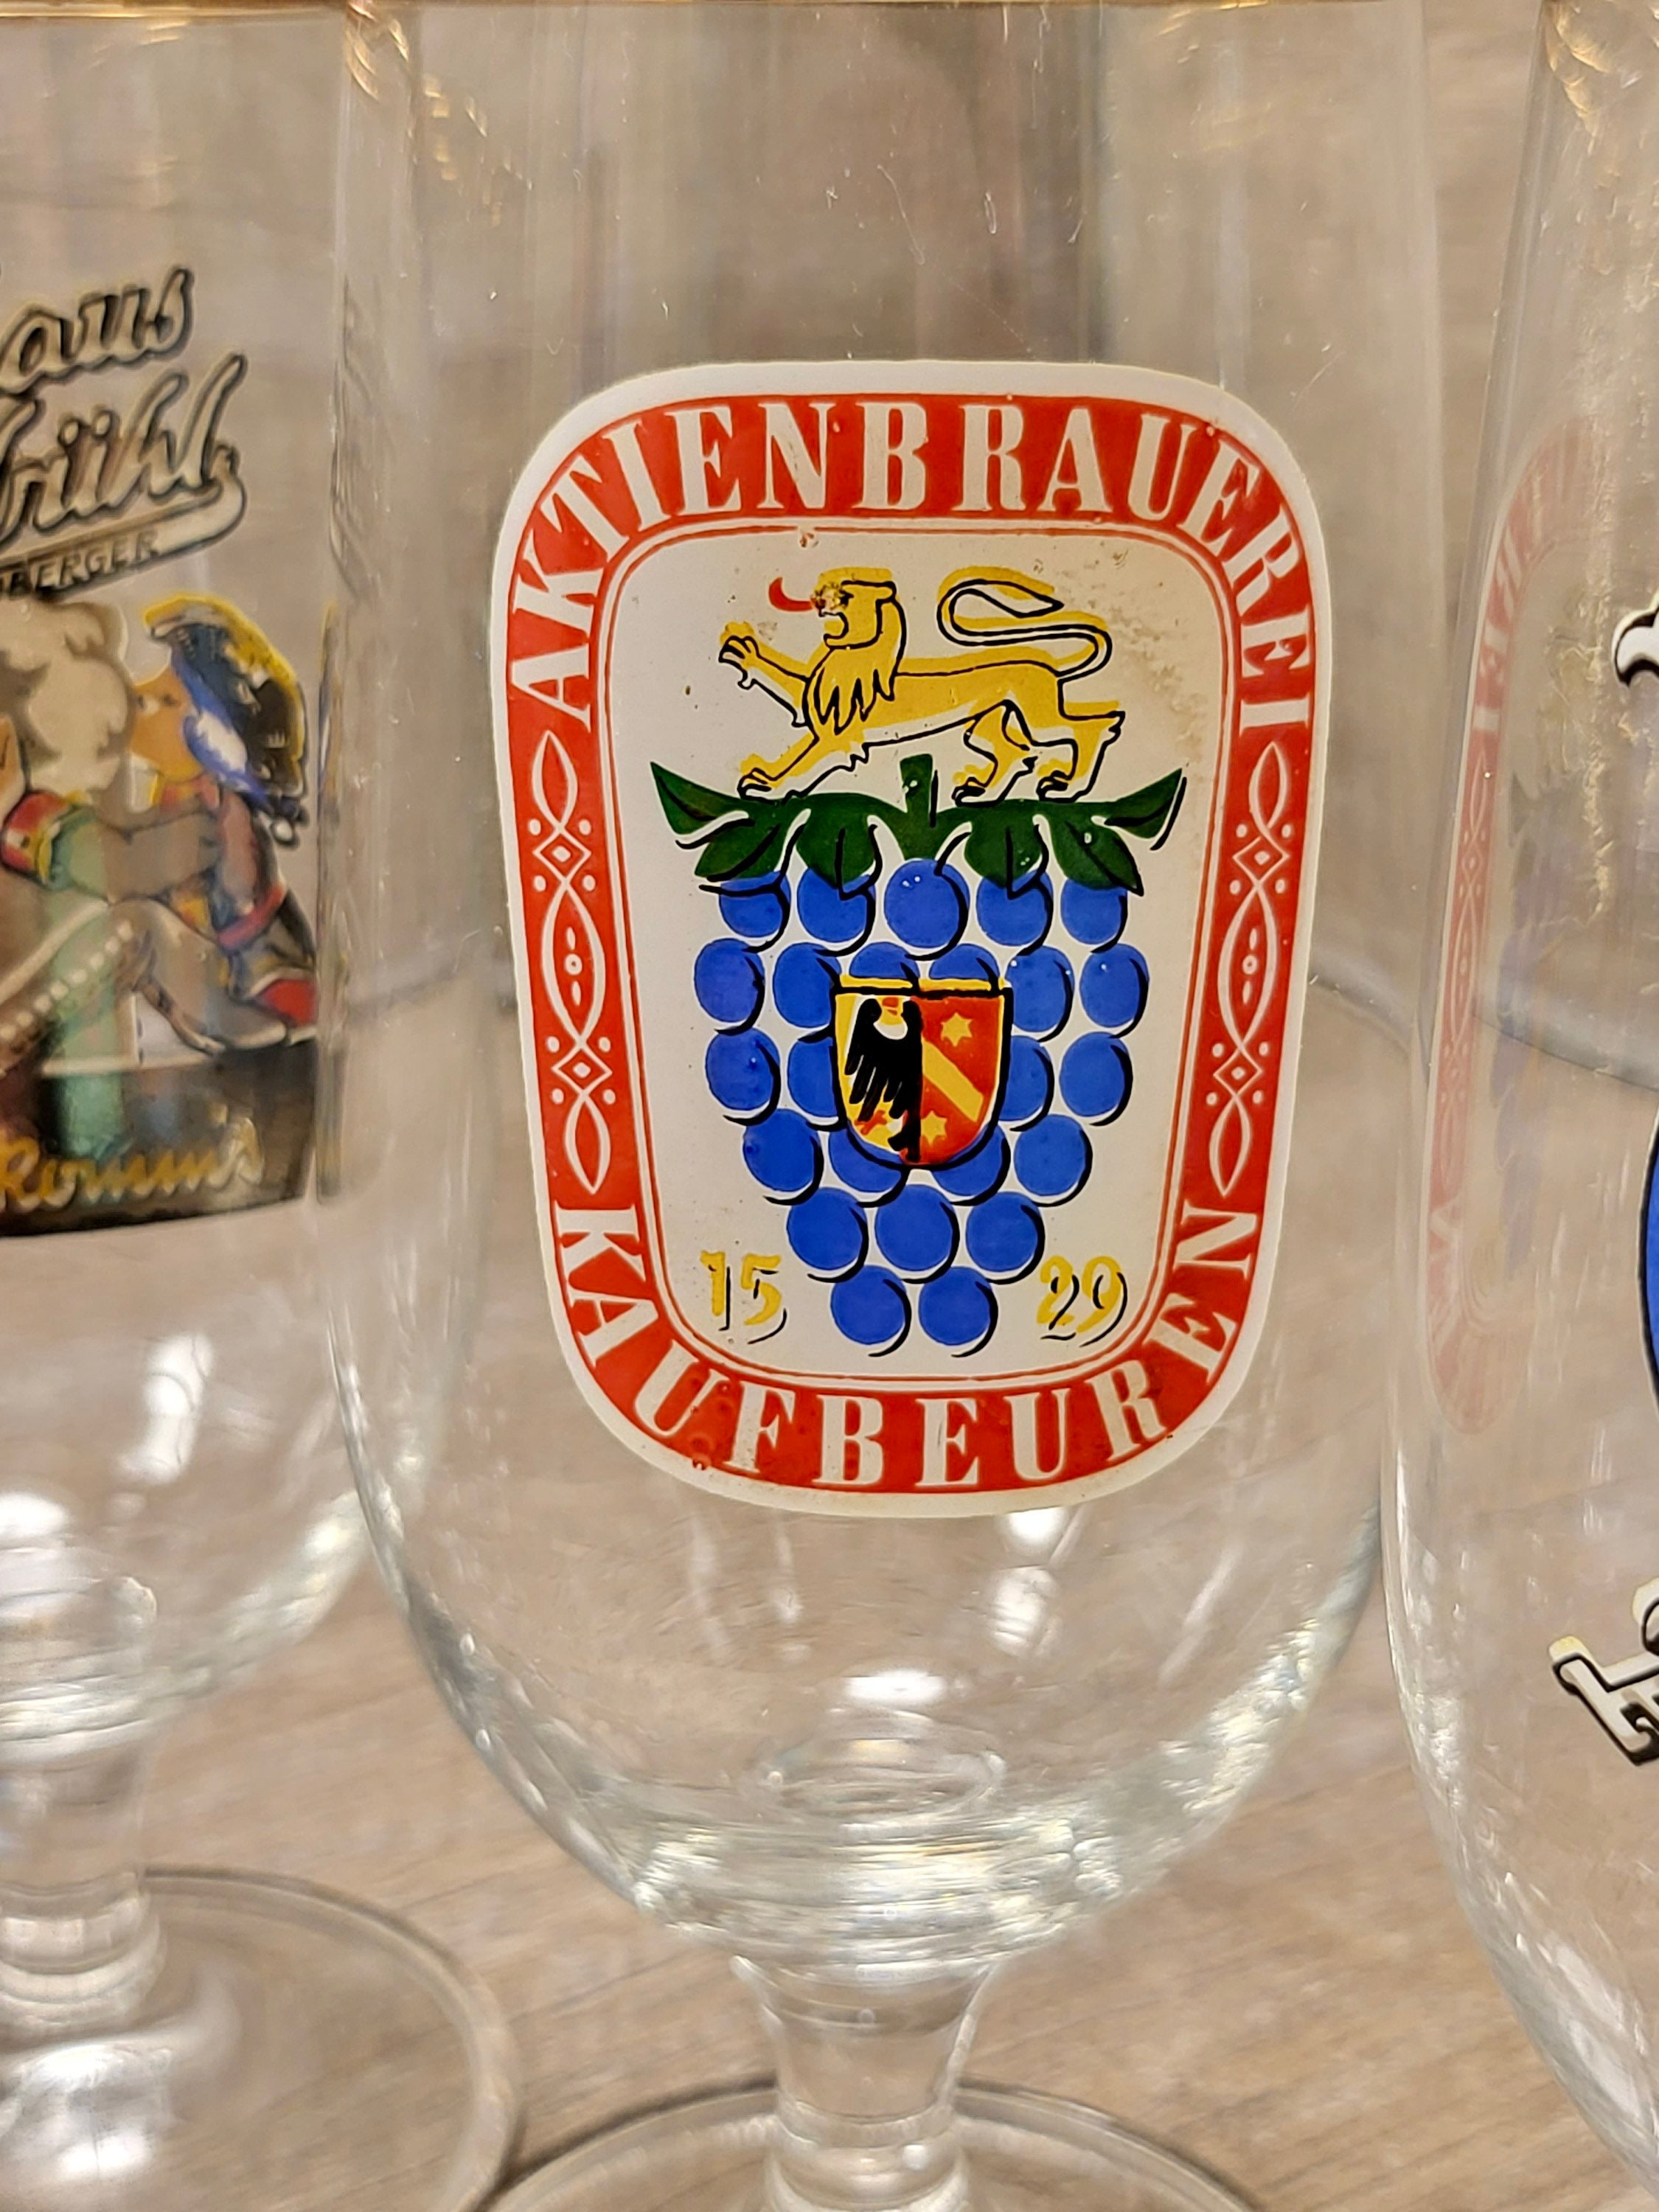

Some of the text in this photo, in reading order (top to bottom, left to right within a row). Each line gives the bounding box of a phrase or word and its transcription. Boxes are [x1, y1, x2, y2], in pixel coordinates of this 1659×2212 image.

[0, 264, 194, 394] aus
[511, 402, 1310, 737] AKTIENBRAUEREI
[554, 1199, 1257, 1490] KAUFBEUREN
[700, 1250, 1128, 1348] 15 29
